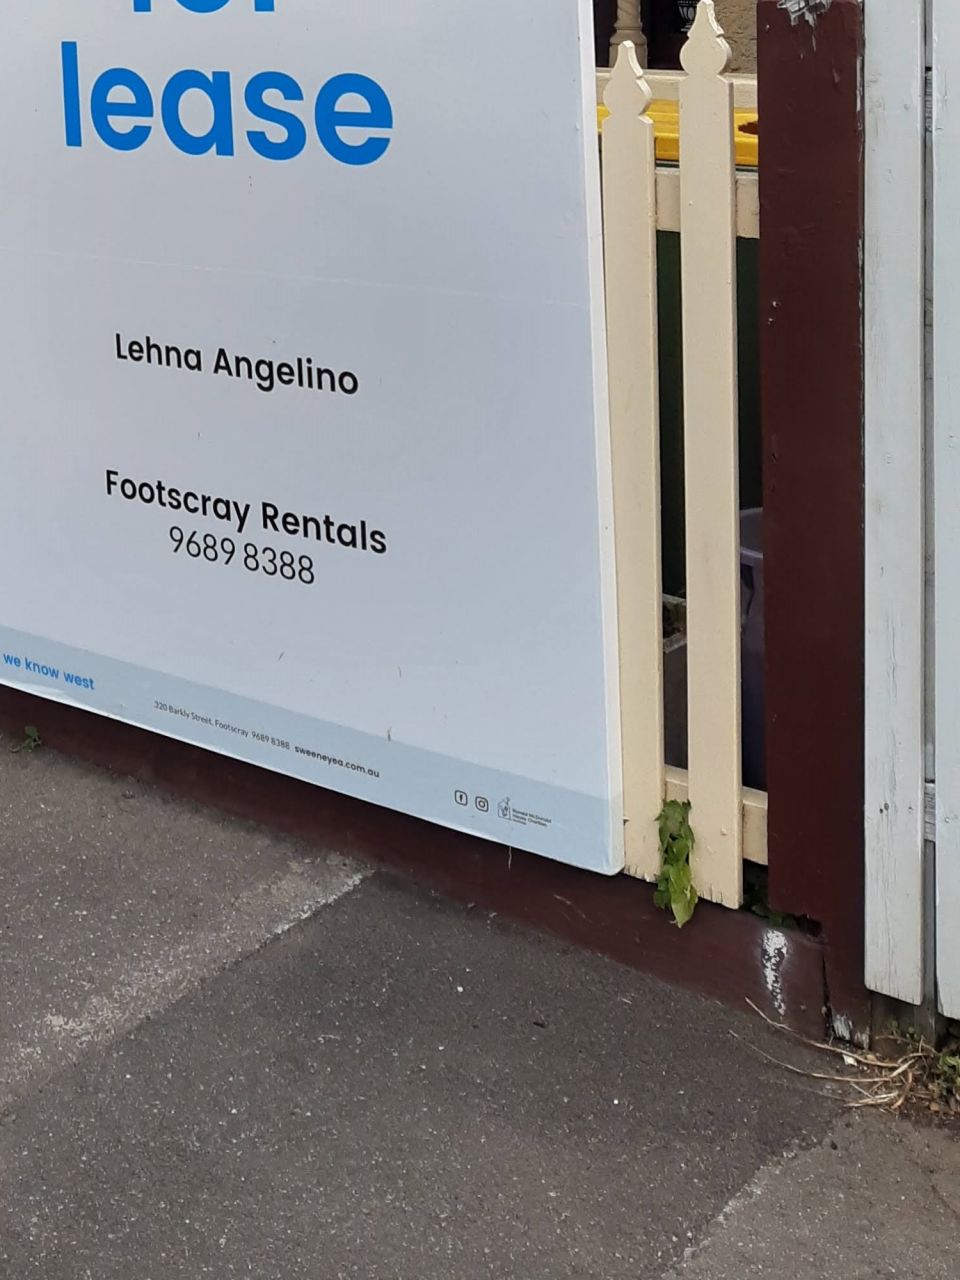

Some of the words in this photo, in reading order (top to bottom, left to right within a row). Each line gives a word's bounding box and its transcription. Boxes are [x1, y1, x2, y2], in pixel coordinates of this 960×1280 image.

[61, 41, 394, 166] lease
[115, 332, 202, 372] Lehna
[213, 347, 359, 395] Angelino
[105, 469, 251, 534] Footscray
[261, 501, 387, 555] Rentals
[169, 526, 236, 565] 9689
[243, 542, 315, 585] 8388
[3, 653, 21, 668] we
[24, 656, 60, 680] know
[63, 671, 95, 690] west
[168, 705, 190, 720] Barkly
[214, 720, 249, 738] Footscray
[251, 730, 270, 744] 9689
[270, 737, 290, 750] 8388
[294, 745, 381, 778] sweeneyea.com.au
